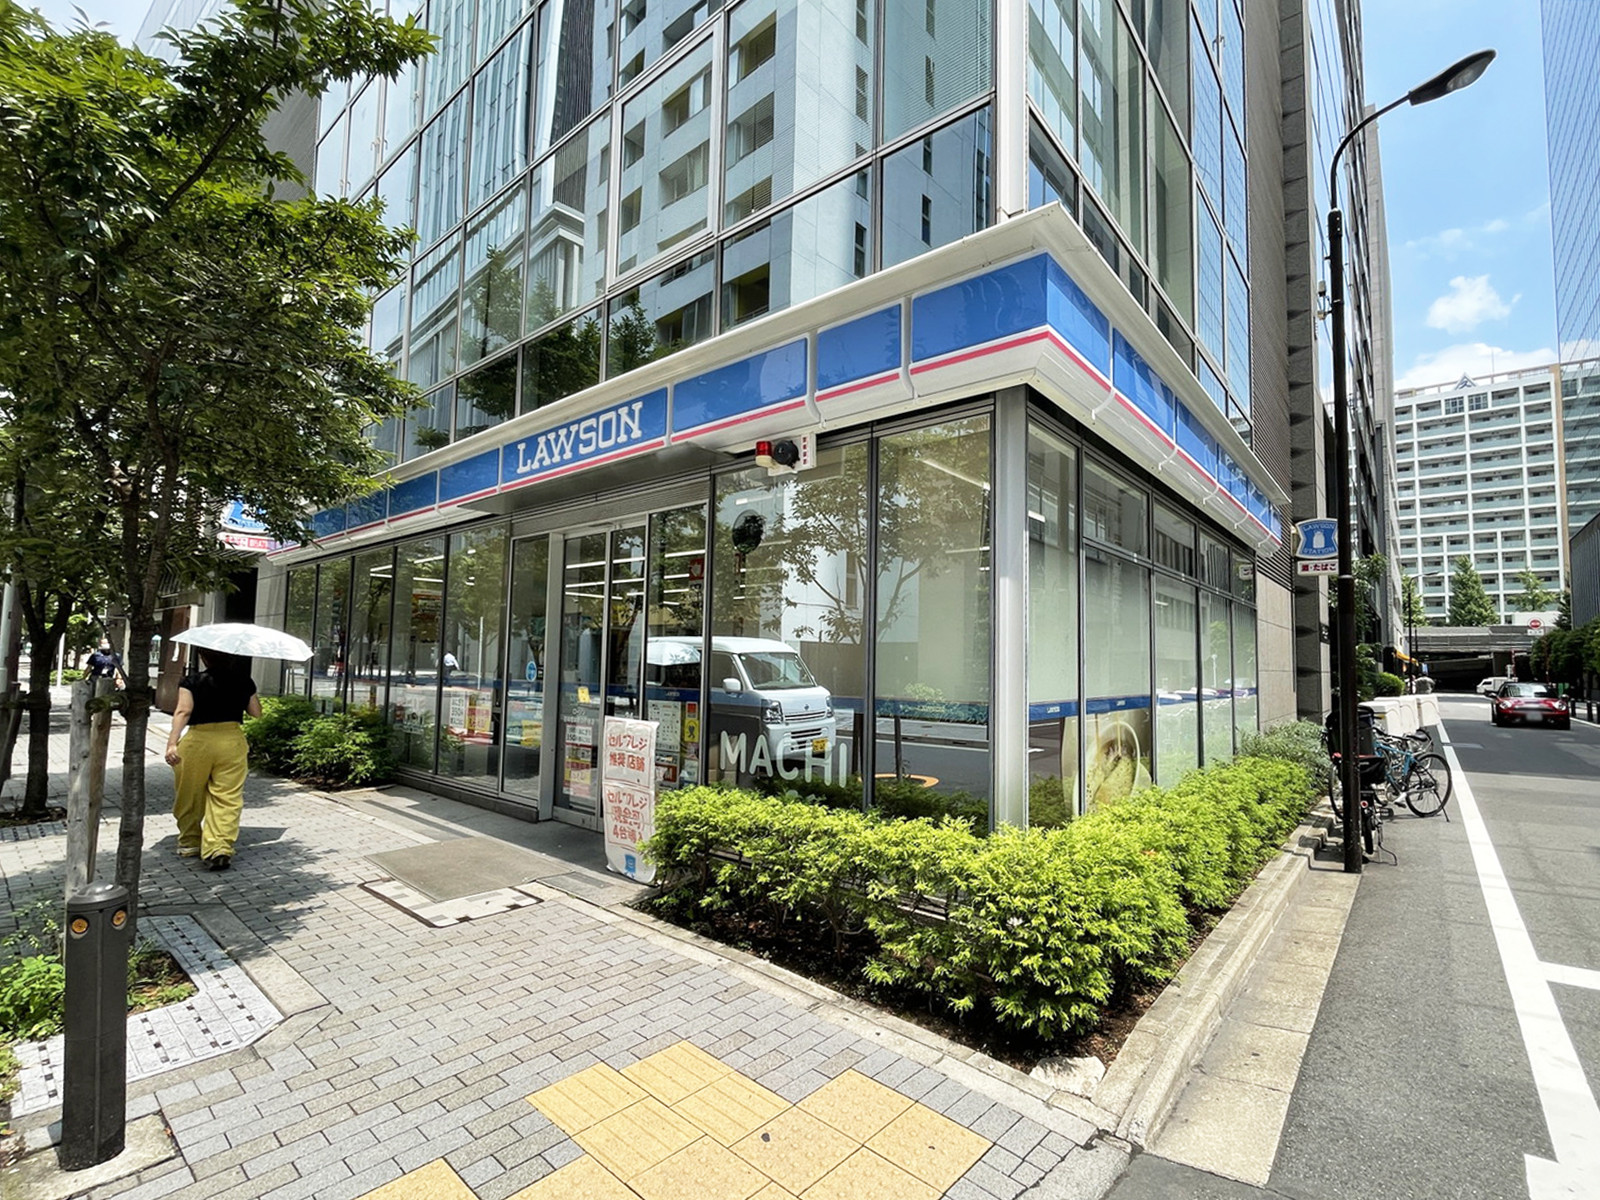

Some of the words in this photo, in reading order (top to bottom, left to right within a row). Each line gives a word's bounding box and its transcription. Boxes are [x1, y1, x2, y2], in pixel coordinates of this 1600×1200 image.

[516, 401, 643, 474] LAWSON
[1303, 523, 1335, 531] LAWSON
[608, 734, 648, 750] セルフレジ
[720, 730, 847, 788] MACHI
[607, 789, 648, 809] セルフレジ
